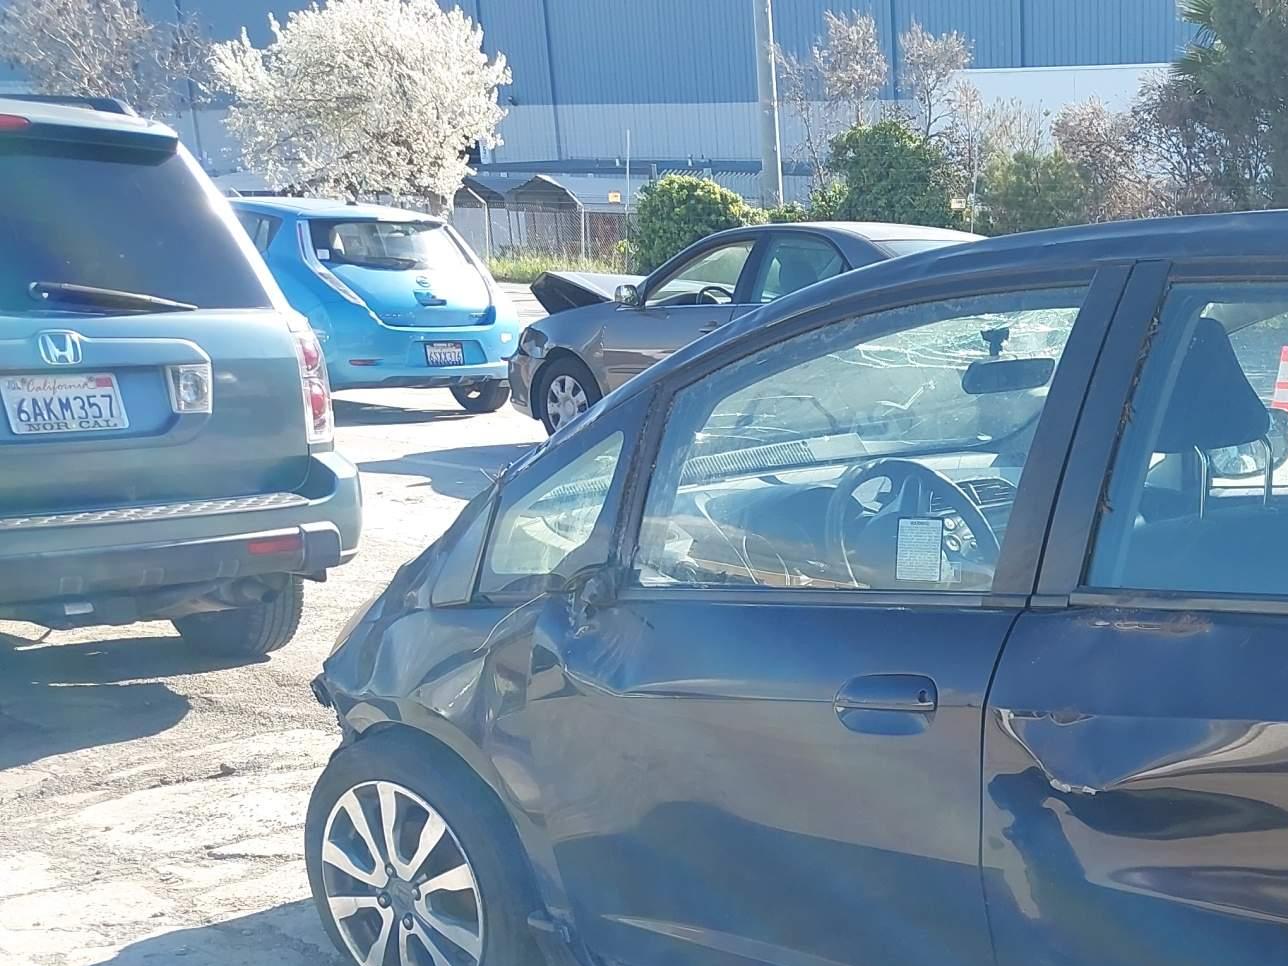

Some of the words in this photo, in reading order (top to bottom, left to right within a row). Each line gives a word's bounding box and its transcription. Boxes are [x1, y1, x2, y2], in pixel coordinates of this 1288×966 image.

[26, 377, 89, 394] California
[17, 394, 114, 422] 6AKM357
[25, 421, 71, 432] NOR
[79, 419, 118, 429] CAL
